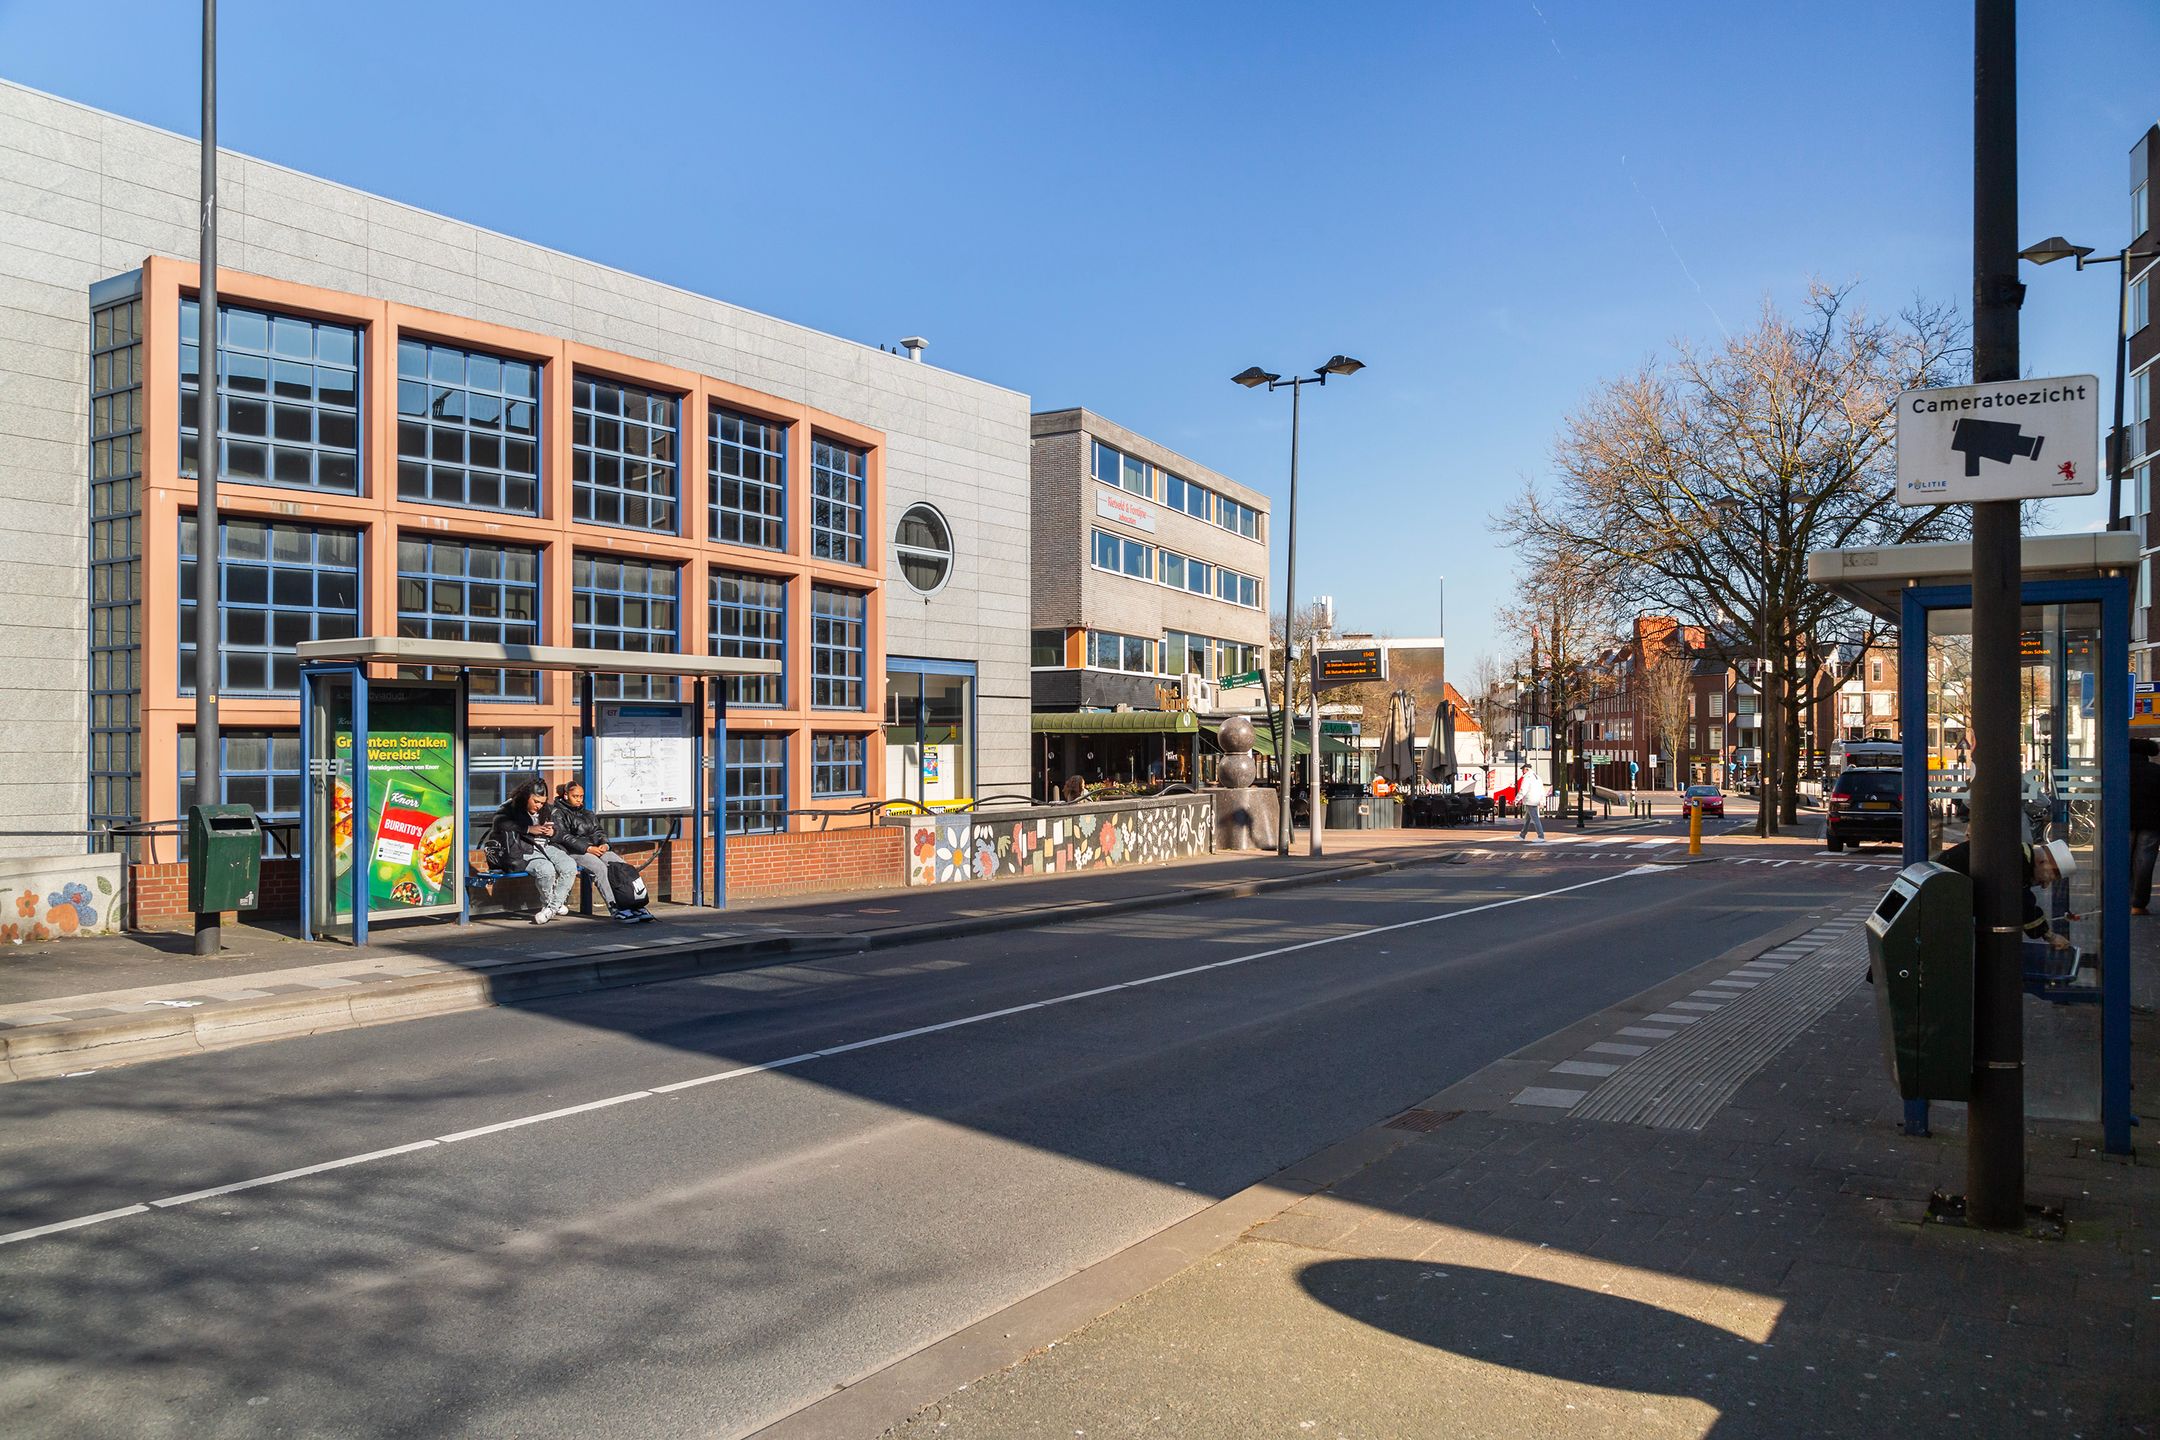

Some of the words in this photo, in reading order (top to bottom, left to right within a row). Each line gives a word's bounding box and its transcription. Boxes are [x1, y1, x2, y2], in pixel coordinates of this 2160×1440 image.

[1912, 385, 2086, 414] Cameratoezicht
[1908, 480, 1947, 490] POLITIE
[336, 737, 398, 749] Grnten
[399, 736, 447, 748] Smaken
[368, 750, 421, 762] Werelds!
[391, 791, 420, 808] Knorr
[384, 818, 424, 837] BURRITO'S
